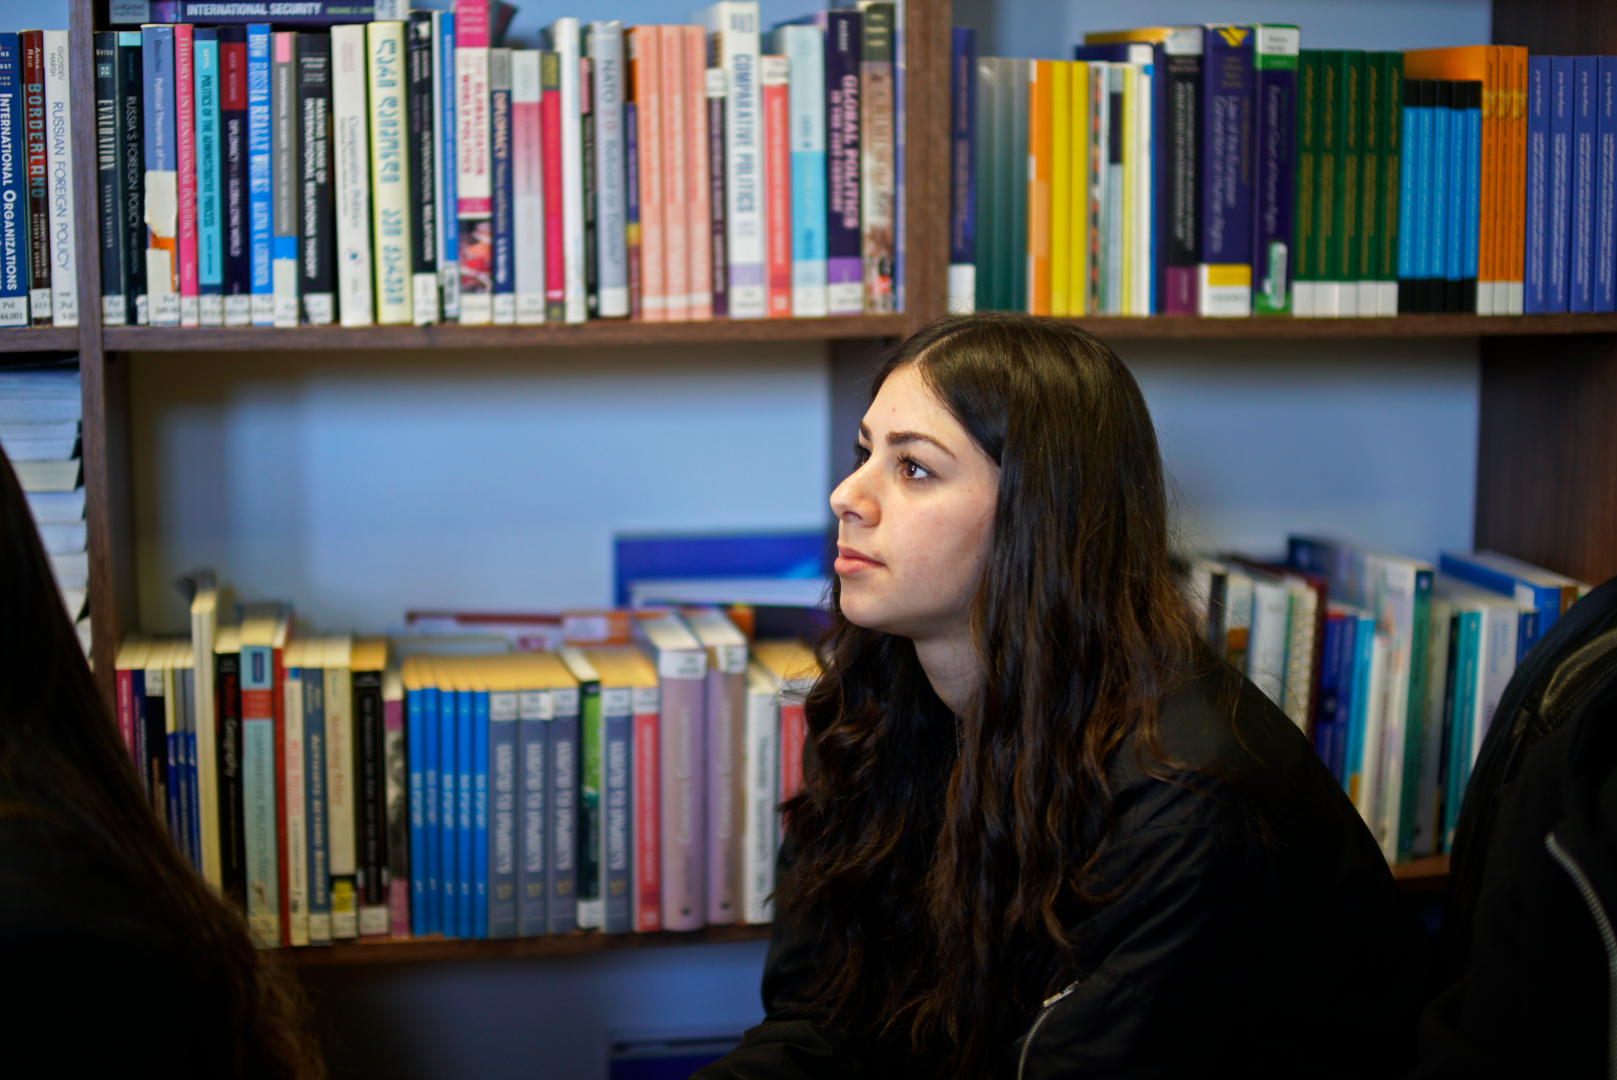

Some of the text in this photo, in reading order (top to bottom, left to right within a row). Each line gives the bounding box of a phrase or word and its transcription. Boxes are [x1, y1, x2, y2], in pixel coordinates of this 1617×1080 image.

[113, 3, 144, 11] palgrave
[186, 3, 268, 16] INTERNATIONAL
[269, 2, 321, 15] SECURITY
[56, 46, 65, 81] GVOSDEV
[179, 36, 191, 80] THEORY
[249, 34, 267, 58] HOW
[154, 77, 165, 111] Political
[201, 74, 213, 107] POLITICS
[250, 61, 268, 101] RUSSIA
[602, 59, 617, 103] NATO
[733, 53, 754, 148] COMPARATIVE
[0, 93, 14, 187] INTERNATIONAL
[98, 99, 116, 171] EVALUATION
[126, 95, 138, 141] RUSSIA'S
[155, 111, 165, 147] Theories
[181, 94, 193, 186] INTERNATIONAL
[202, 119, 213, 133] THE
[251, 102, 269, 151] REALLY
[493, 92, 508, 159] DIPLOMACY
[831, 105, 843, 130] THE
[28, 83, 46, 199] BORDERLAND
[156, 148, 165, 158] of
[229, 119, 240, 163] DIPLOMACY
[315, 97, 327, 184] MAKING SENSE OF
[841, 74, 860, 229] GLOBAL POLITICS
[52, 101, 71, 272] RUSSIAN FOREIGN POLICY
[127, 142, 139, 191] FOREIGN
[203, 134, 214, 194] ADMINISTRATIVE
[252, 154, 270, 194] WORKS
[736, 152, 756, 213] POLITICS
[304, 97, 317, 279] INTERNATIONAL RELATIONS THEORY
[33, 213, 41, 241] HISTORY
[128, 192, 139, 230] POLICY
[182, 187, 194, 239] POLITICS
[422, 204, 433, 262] RELATIONS
[2, 189, 18, 291] ORGANIZATIONS
[33, 241, 41, 250] OF
[2, 301, 15, 310] Pol
[222, 718, 240, 779] Geography
